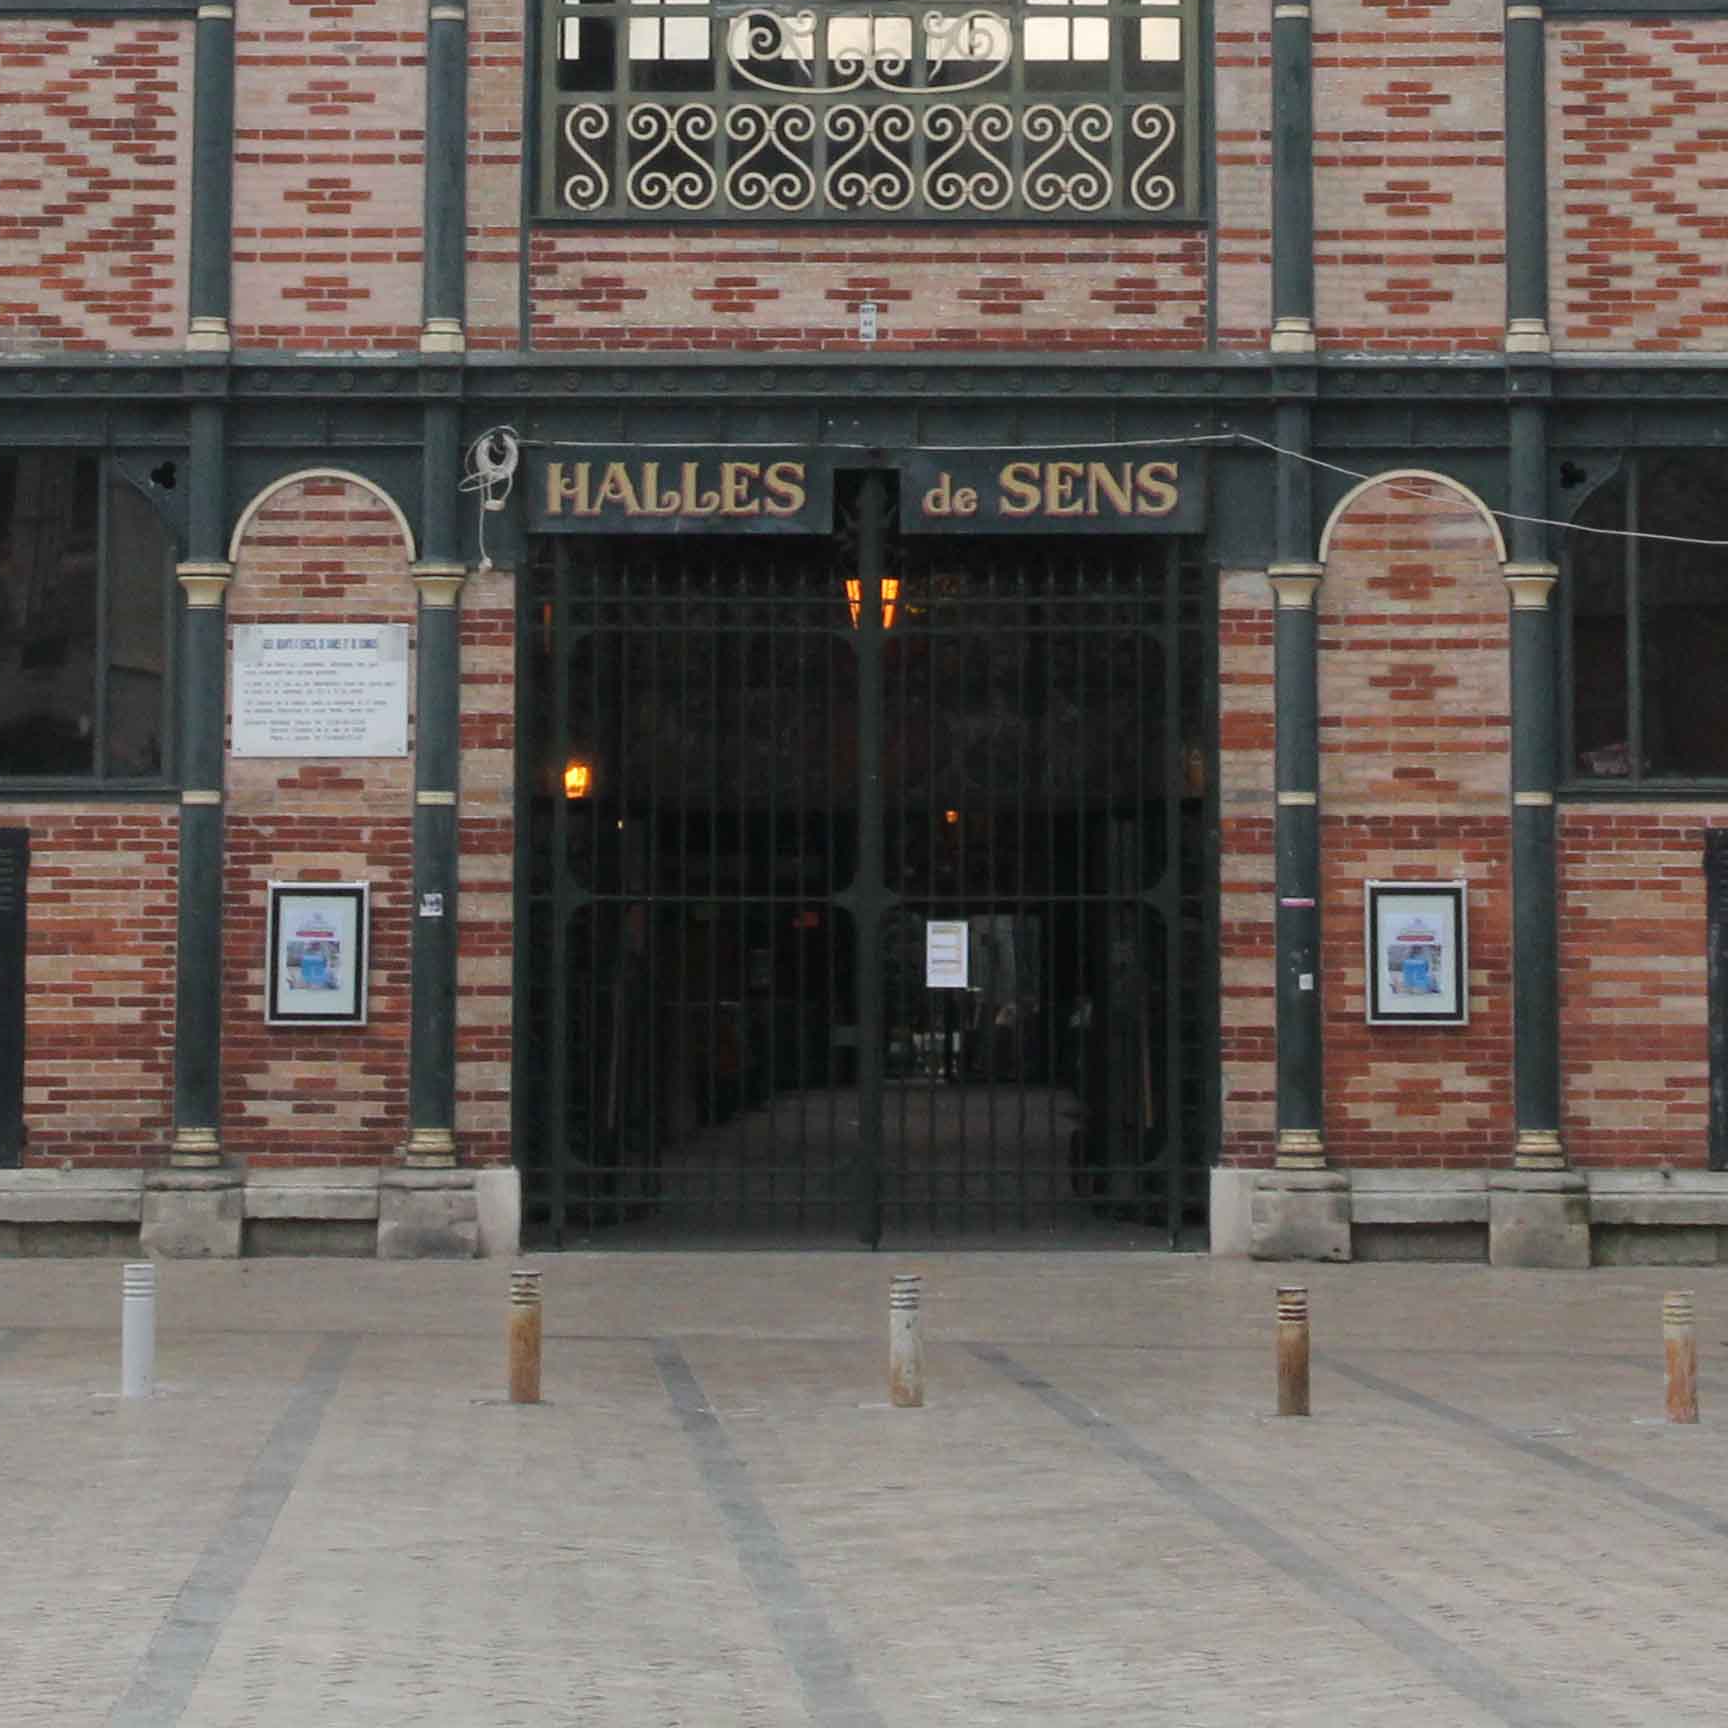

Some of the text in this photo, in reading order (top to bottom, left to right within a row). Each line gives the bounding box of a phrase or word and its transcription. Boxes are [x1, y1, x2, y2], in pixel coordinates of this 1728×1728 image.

[545, 462, 1179, 516] HALLES de SENS
